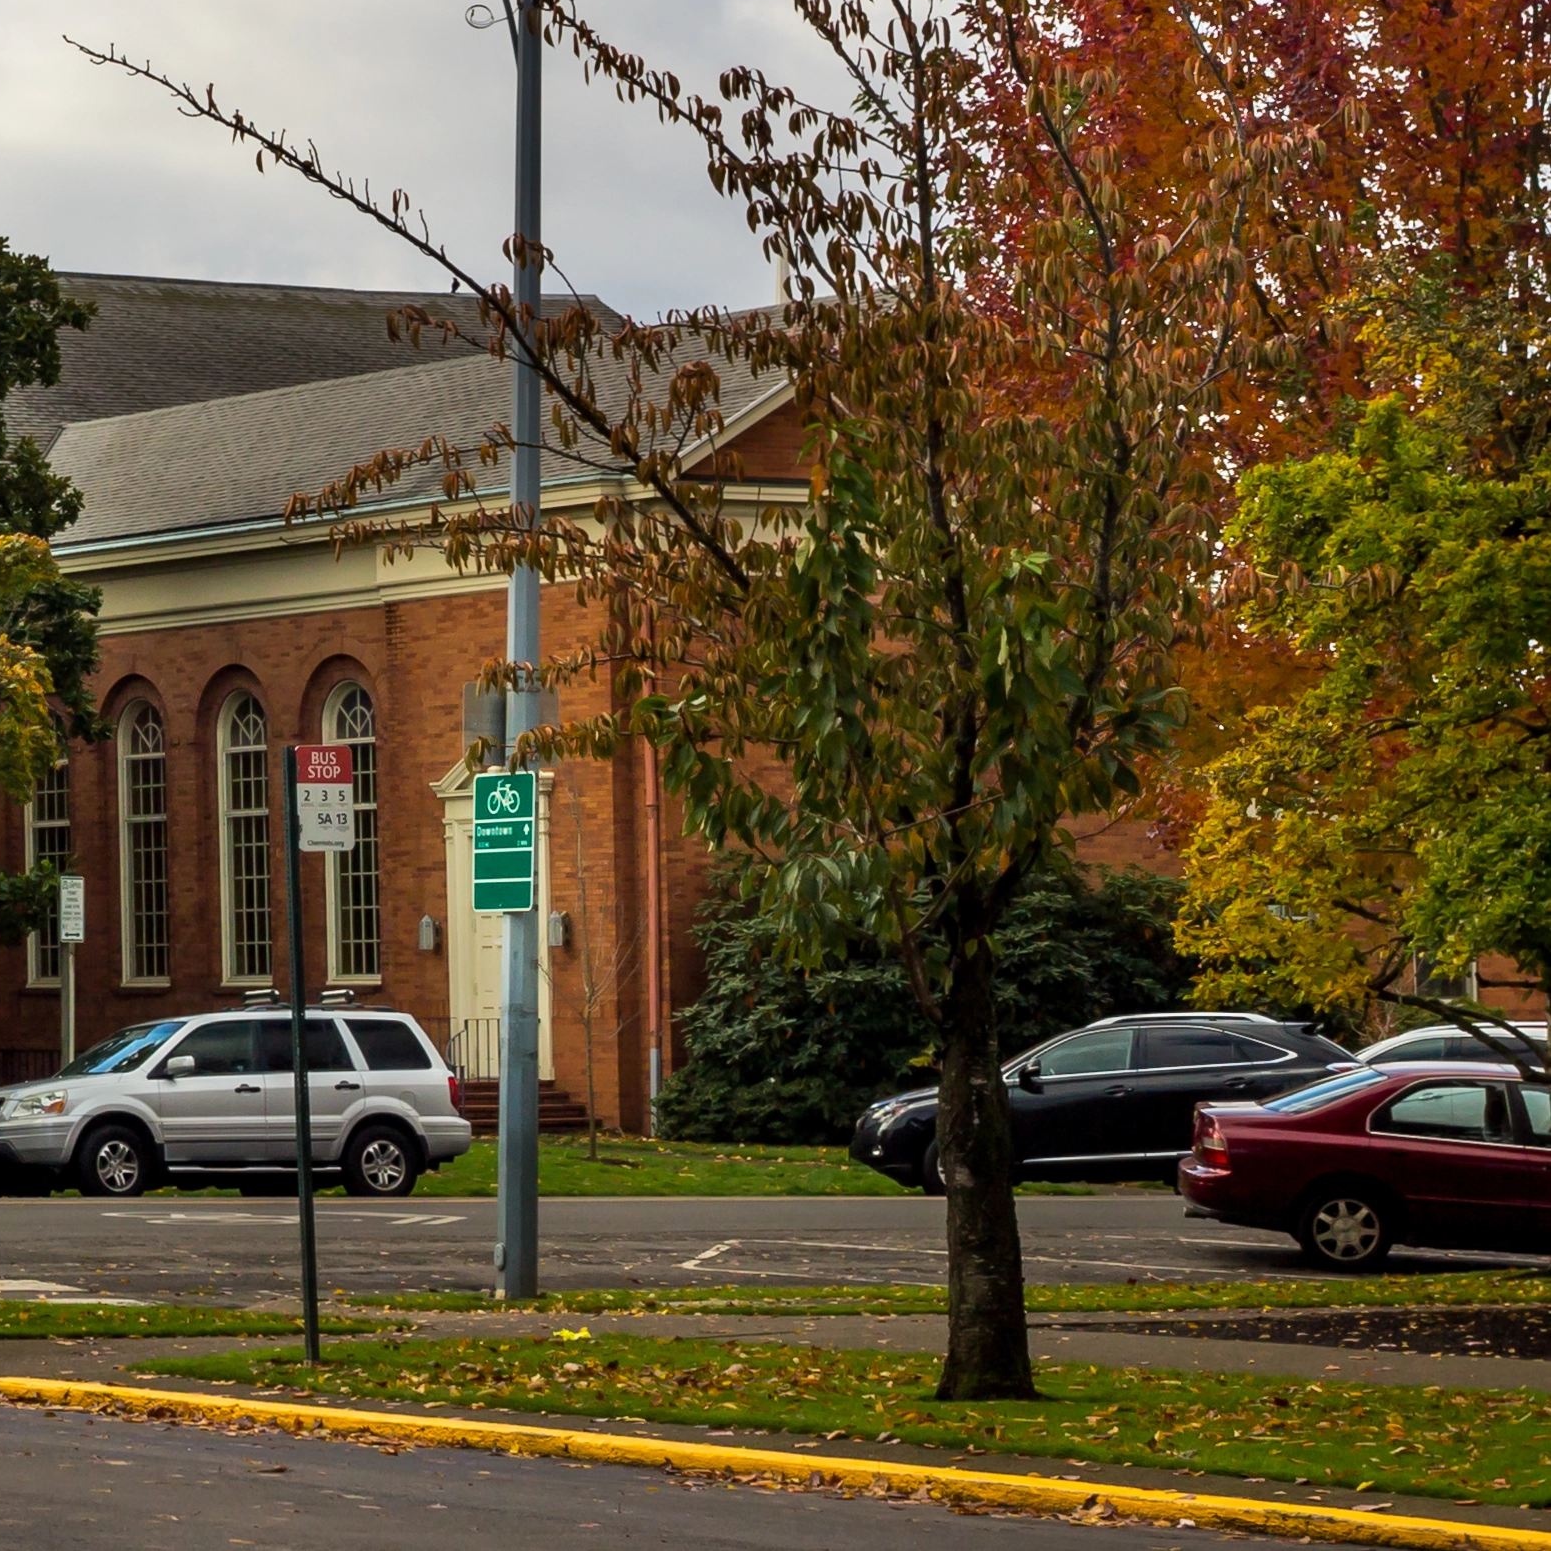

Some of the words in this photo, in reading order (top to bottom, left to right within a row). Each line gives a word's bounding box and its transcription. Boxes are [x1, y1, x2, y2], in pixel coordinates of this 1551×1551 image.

[311, 751, 337, 765] BUS
[307, 766, 341, 779] STOP
[304, 790, 310, 802] 2
[322, 790, 328, 802] 3
[338, 790, 346, 802] 5
[318, 813, 332, 824] 5A
[336, 813, 348, 824] 13
[477, 826, 512, 836] Downtown
